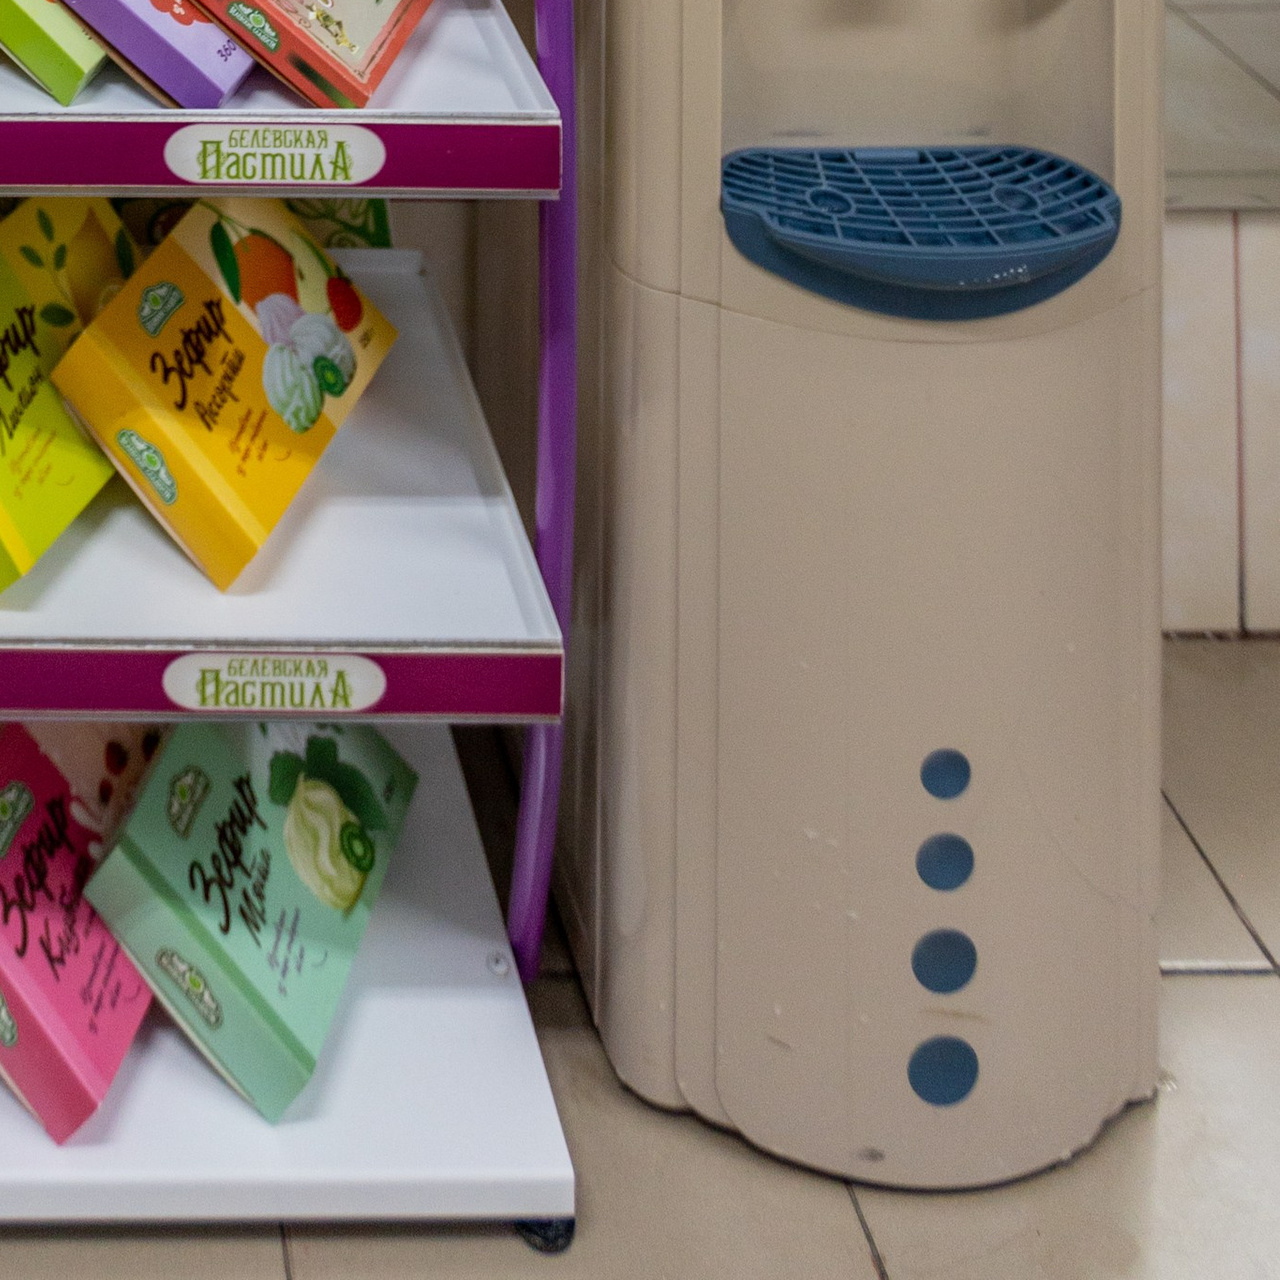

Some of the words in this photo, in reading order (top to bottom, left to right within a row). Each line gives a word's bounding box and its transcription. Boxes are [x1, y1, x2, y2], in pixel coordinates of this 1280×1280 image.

[216, 39, 237, 63] 360
[227, 127, 328, 150] БЕЛЁВСКАЯ
[150, 298, 234, 412] Зефир
[194, 347, 246, 432] Ассорти
[227, 656, 328, 679] БЕЛЁВСКАЯ
[189, 771, 268, 935] Зефир
